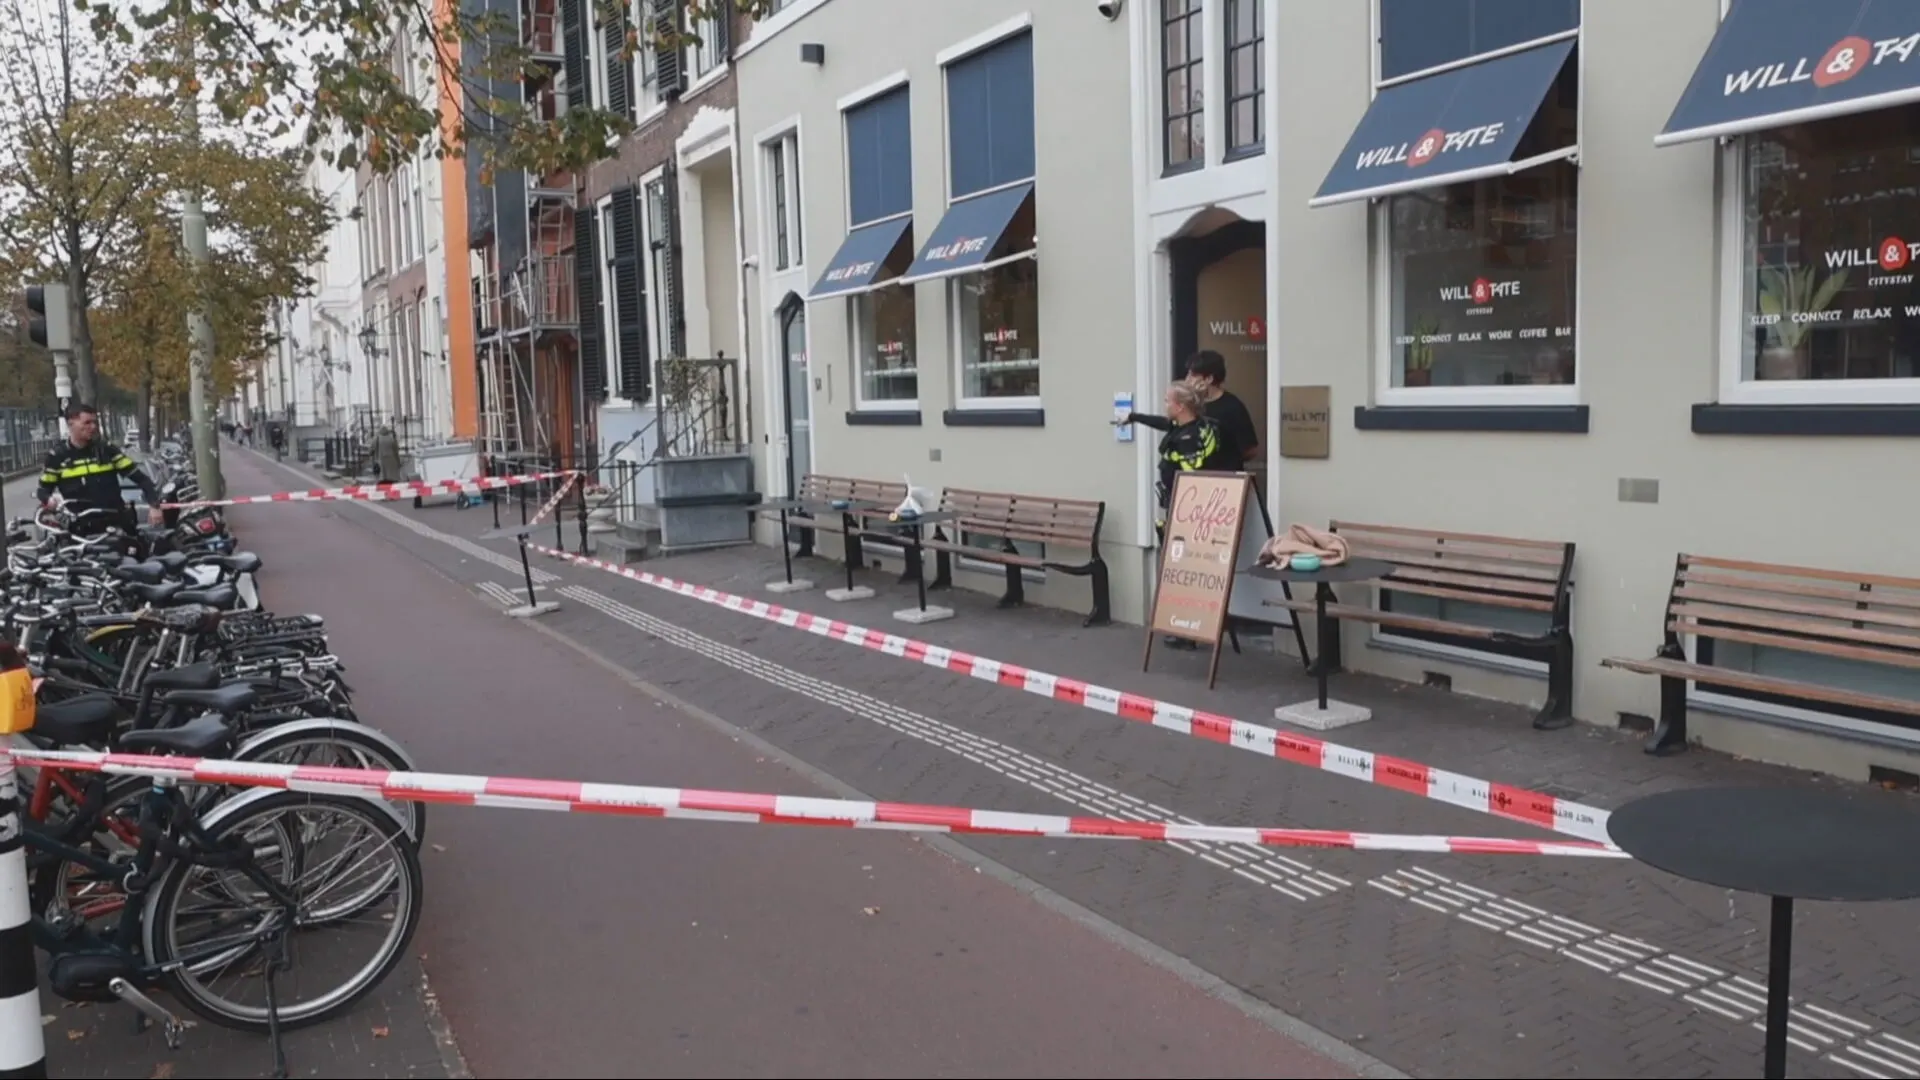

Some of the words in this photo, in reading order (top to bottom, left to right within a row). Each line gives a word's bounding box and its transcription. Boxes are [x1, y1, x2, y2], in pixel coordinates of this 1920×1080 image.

[1723, 57, 1811, 96] WILL
[1825, 47, 1855, 74] &
[1873, 32, 1920, 65] TA
[1355, 142, 1409, 171] WILL
[1415, 137, 1434, 158] &
[1442, 122, 1504, 152] TATE
[925, 247, 949, 261] WILL
[1824, 247, 1878, 268] WILL
[1885, 244, 1900, 262] &
[1906, 242, 1920, 261] T
[1439, 285, 1472, 301] WILL
[1475, 284, 1485, 298] &
[1489, 280, 1521, 297] TATE
[1868, 274, 1914, 286] CITYSTAY
[1751, 313, 1781, 325] SLEEP
[1791, 310, 1842, 323] CONNECT
[1853, 307, 1892, 320] RELAX
[1209, 321, 1246, 336] WILL
[1250, 320, 1260, 334] &
[1175, 484, 1237, 542] Coffee
[1163, 567, 1225, 591] RECEPTION
